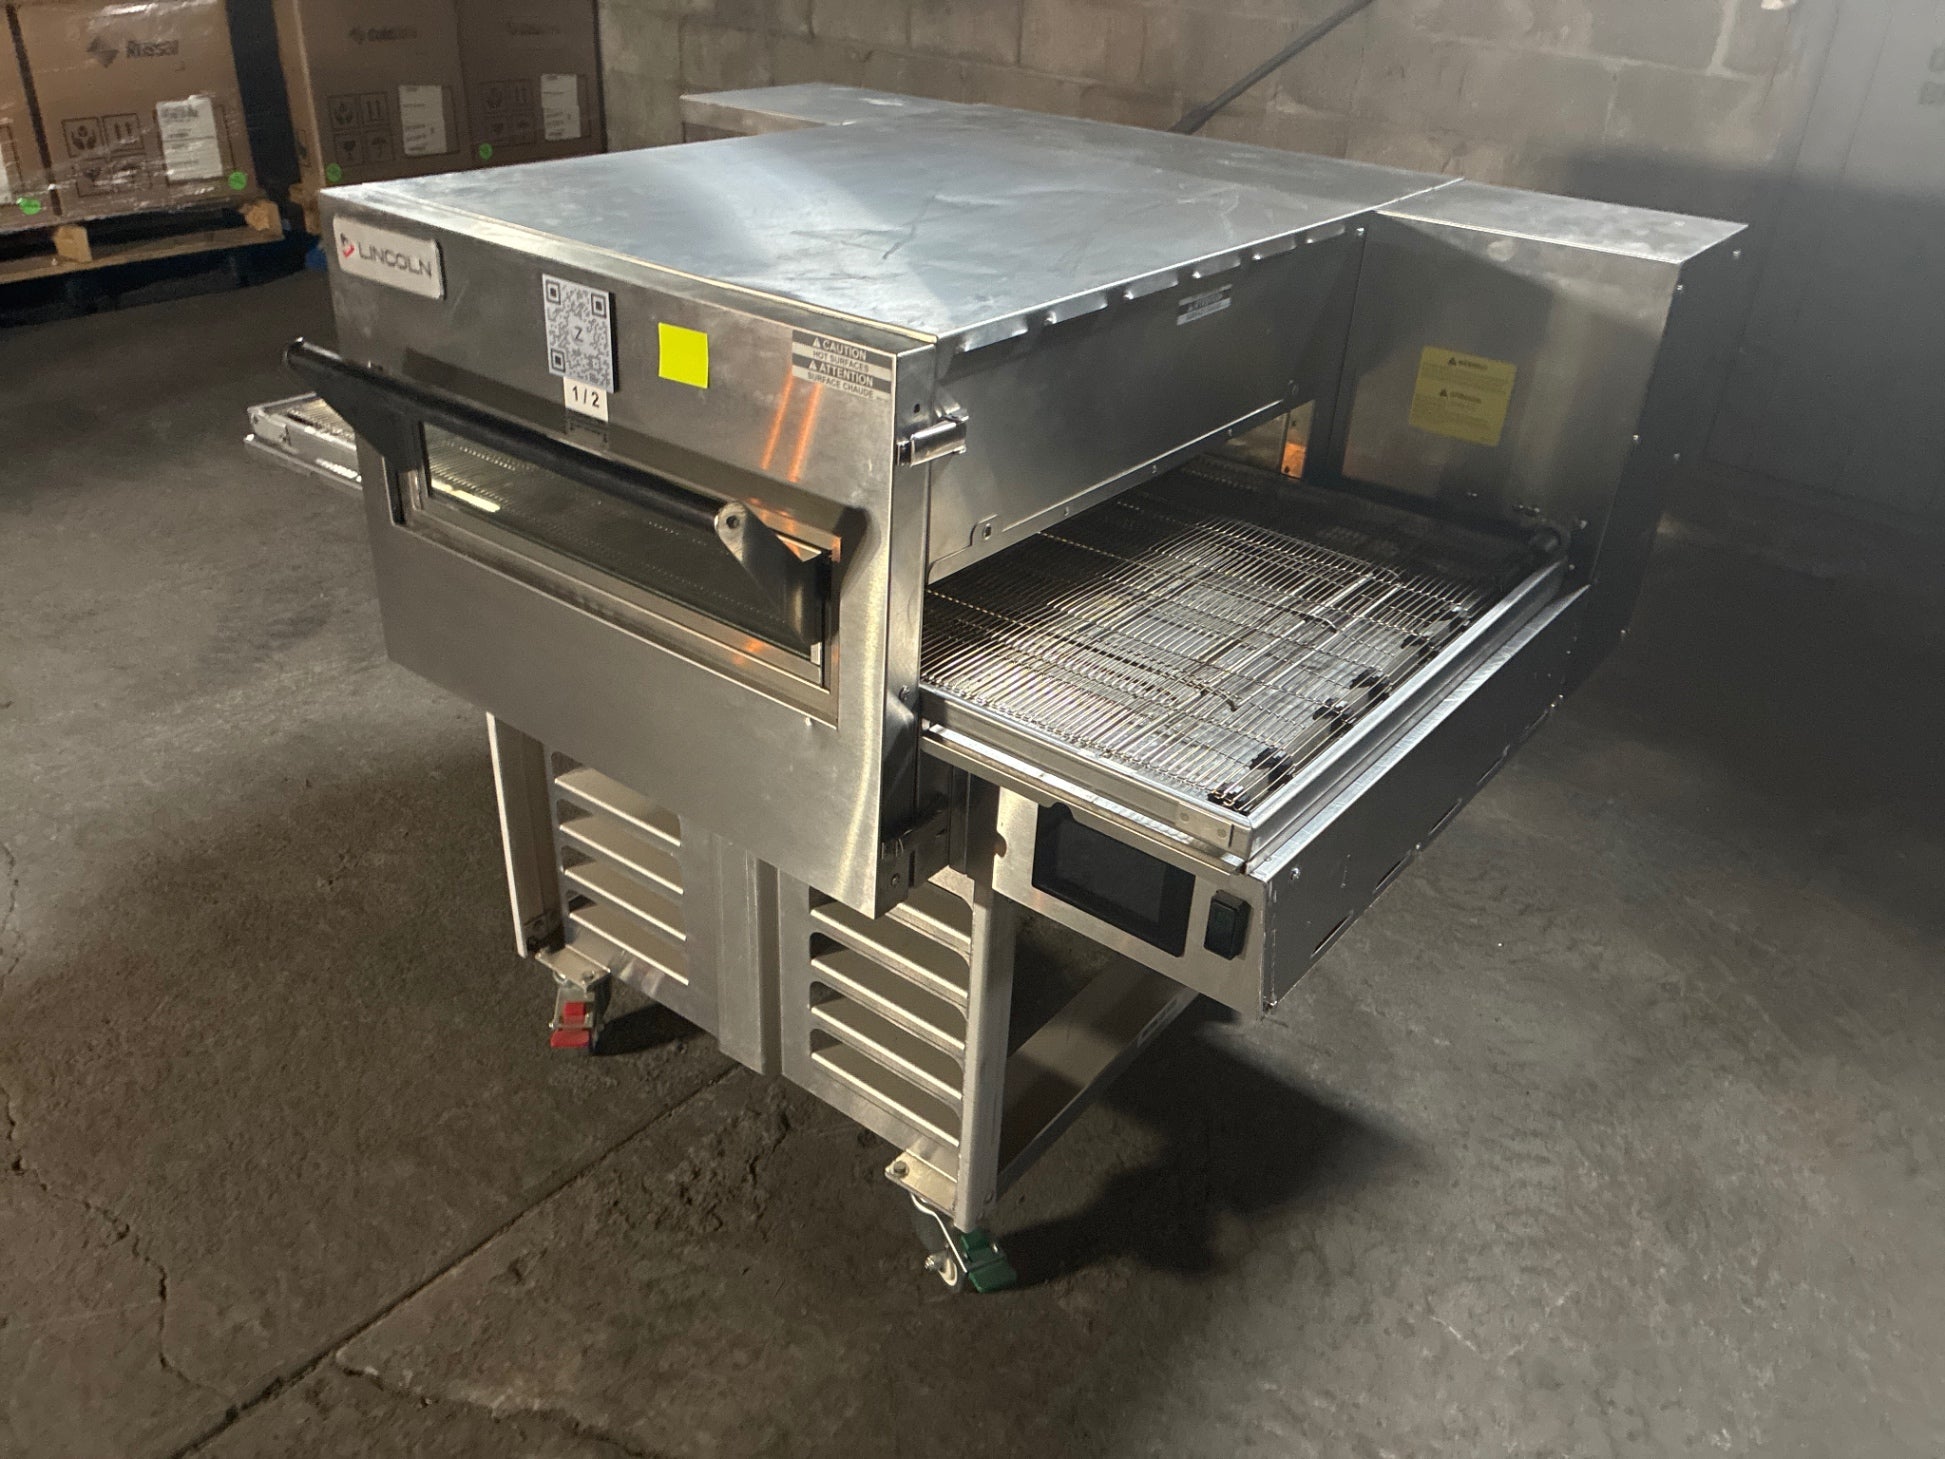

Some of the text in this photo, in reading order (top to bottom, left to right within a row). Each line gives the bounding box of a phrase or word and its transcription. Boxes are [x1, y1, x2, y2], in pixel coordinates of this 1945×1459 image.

[358, 241, 432, 279] LINCOLN
[573, 326, 583, 342] Z
[813, 350, 869, 373] HOT SURFACES
[822, 339, 867, 361] CAUTION
[807, 371, 874, 397] SURFACE CHAUDE
[819, 362, 873, 387] ATTENTION
